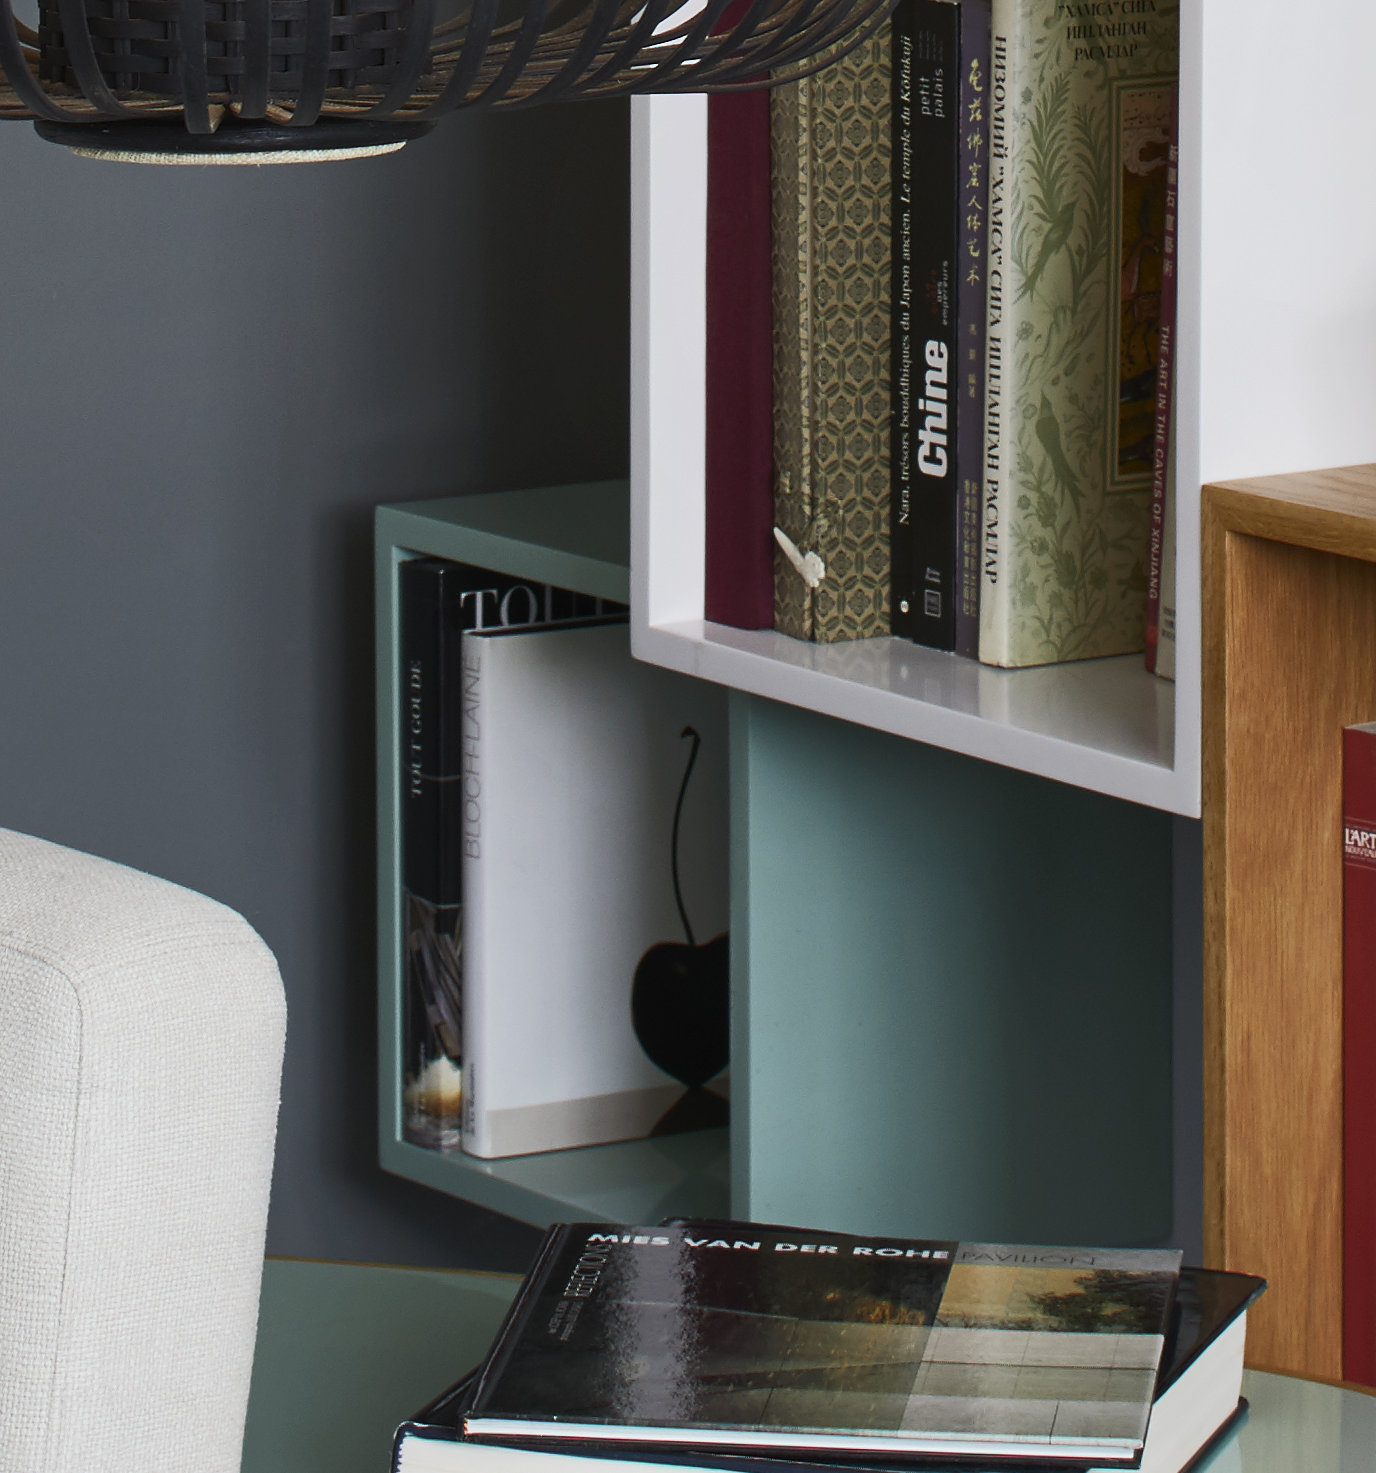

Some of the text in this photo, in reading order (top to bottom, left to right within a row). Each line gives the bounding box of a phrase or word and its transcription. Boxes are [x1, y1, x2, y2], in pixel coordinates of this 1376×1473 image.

[918, 75, 932, 117] petit
[932, 68, 945, 119] palais
[901, 106, 911, 126] du
[901, 129, 913, 181] temple
[900, 183, 911, 204] Le
[899, 264, 912, 307] Japon
[899, 311, 910, 331] du
[899, 334, 913, 428] bouddhiques
[917, 338, 949, 479] Chine
[1148, 325, 1170, 600] THE ART IN THE CAVES OF XINJIANG
[899, 484, 911, 526] Nara,
[410, 659, 423, 799] TOUT GOUDE
[587, 1233, 1096, 1267] MIES VAN DER ROHE PAVILION
